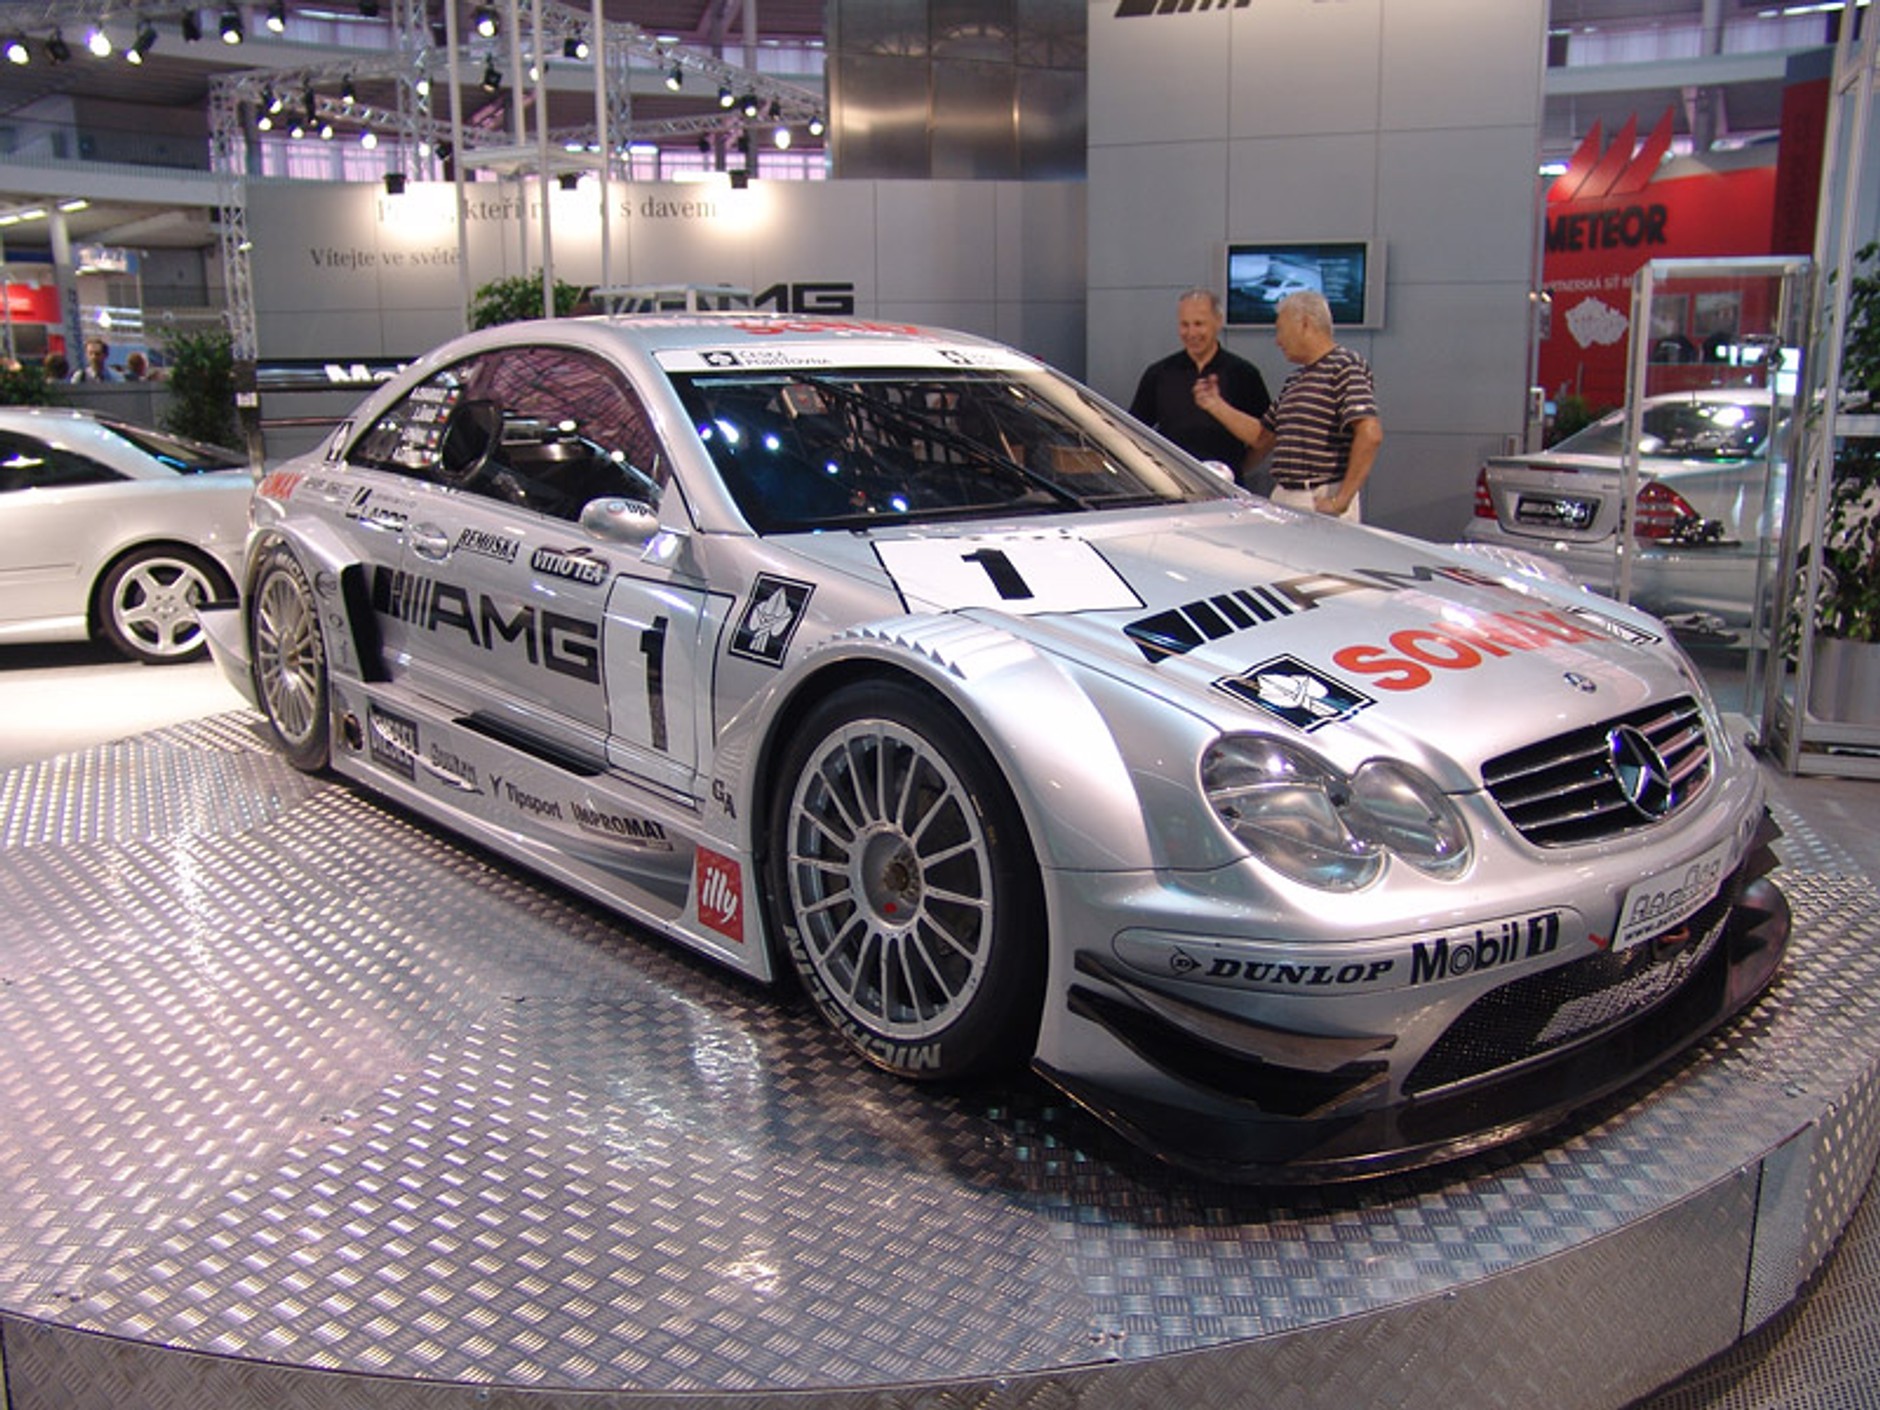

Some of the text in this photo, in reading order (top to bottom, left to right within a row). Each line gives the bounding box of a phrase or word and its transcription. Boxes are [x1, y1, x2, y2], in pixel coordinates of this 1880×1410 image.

[1546, 204, 1667, 252] METEOR
[310, 248, 376, 271] Vítejte
[382, 250, 403, 265] ve
[459, 528, 520, 559] REMOSKA
[960, 548, 1035, 600] 1
[429, 581, 601, 685] AMG
[641, 615, 669, 752] 1
[505, 782, 564, 821] Tipsport
[703, 867, 738, 925] illy
[1205, 958, 1394, 986] DUNLOP
[1409, 922, 1519, 985] Mobil
[1526, 911, 1561, 958] 1
[783, 924, 942, 1069] MICHELIN
